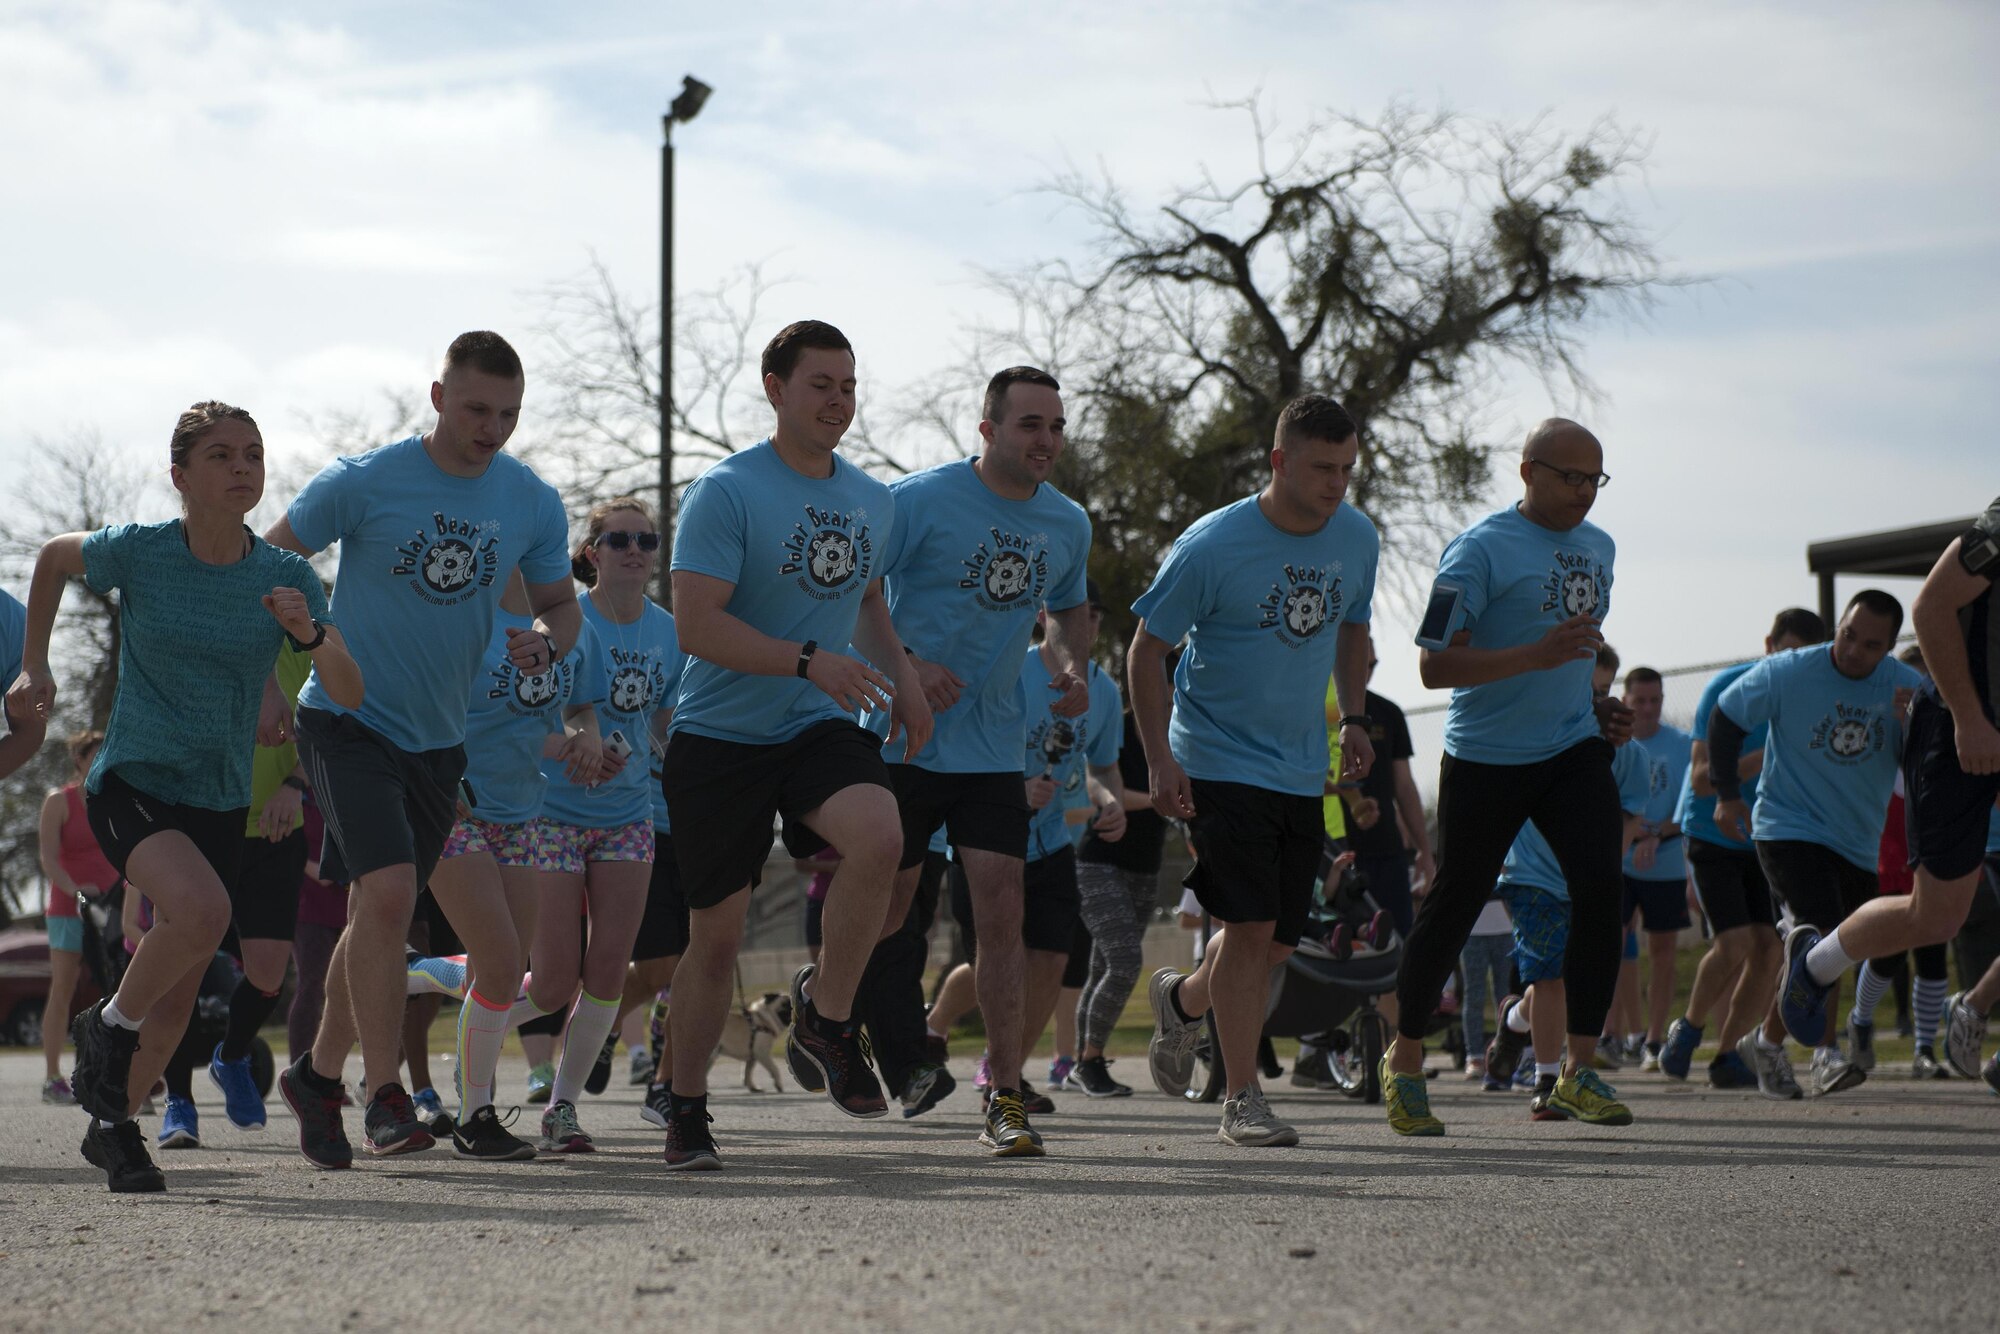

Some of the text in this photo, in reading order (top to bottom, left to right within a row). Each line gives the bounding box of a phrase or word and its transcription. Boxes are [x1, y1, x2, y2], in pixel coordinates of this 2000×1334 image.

[391, 511, 499, 587] Polar Bear Swim
[778, 503, 873, 579] Polar Bear Swim
[959, 526, 1049, 598] Polar Bear Swim
[1256, 563, 1344, 629] Polar Bear Swim
[1541, 567, 1562, 614] Polar
[1553, 550, 1591, 571] Bear
[609, 645, 666, 705] Bear Swim
